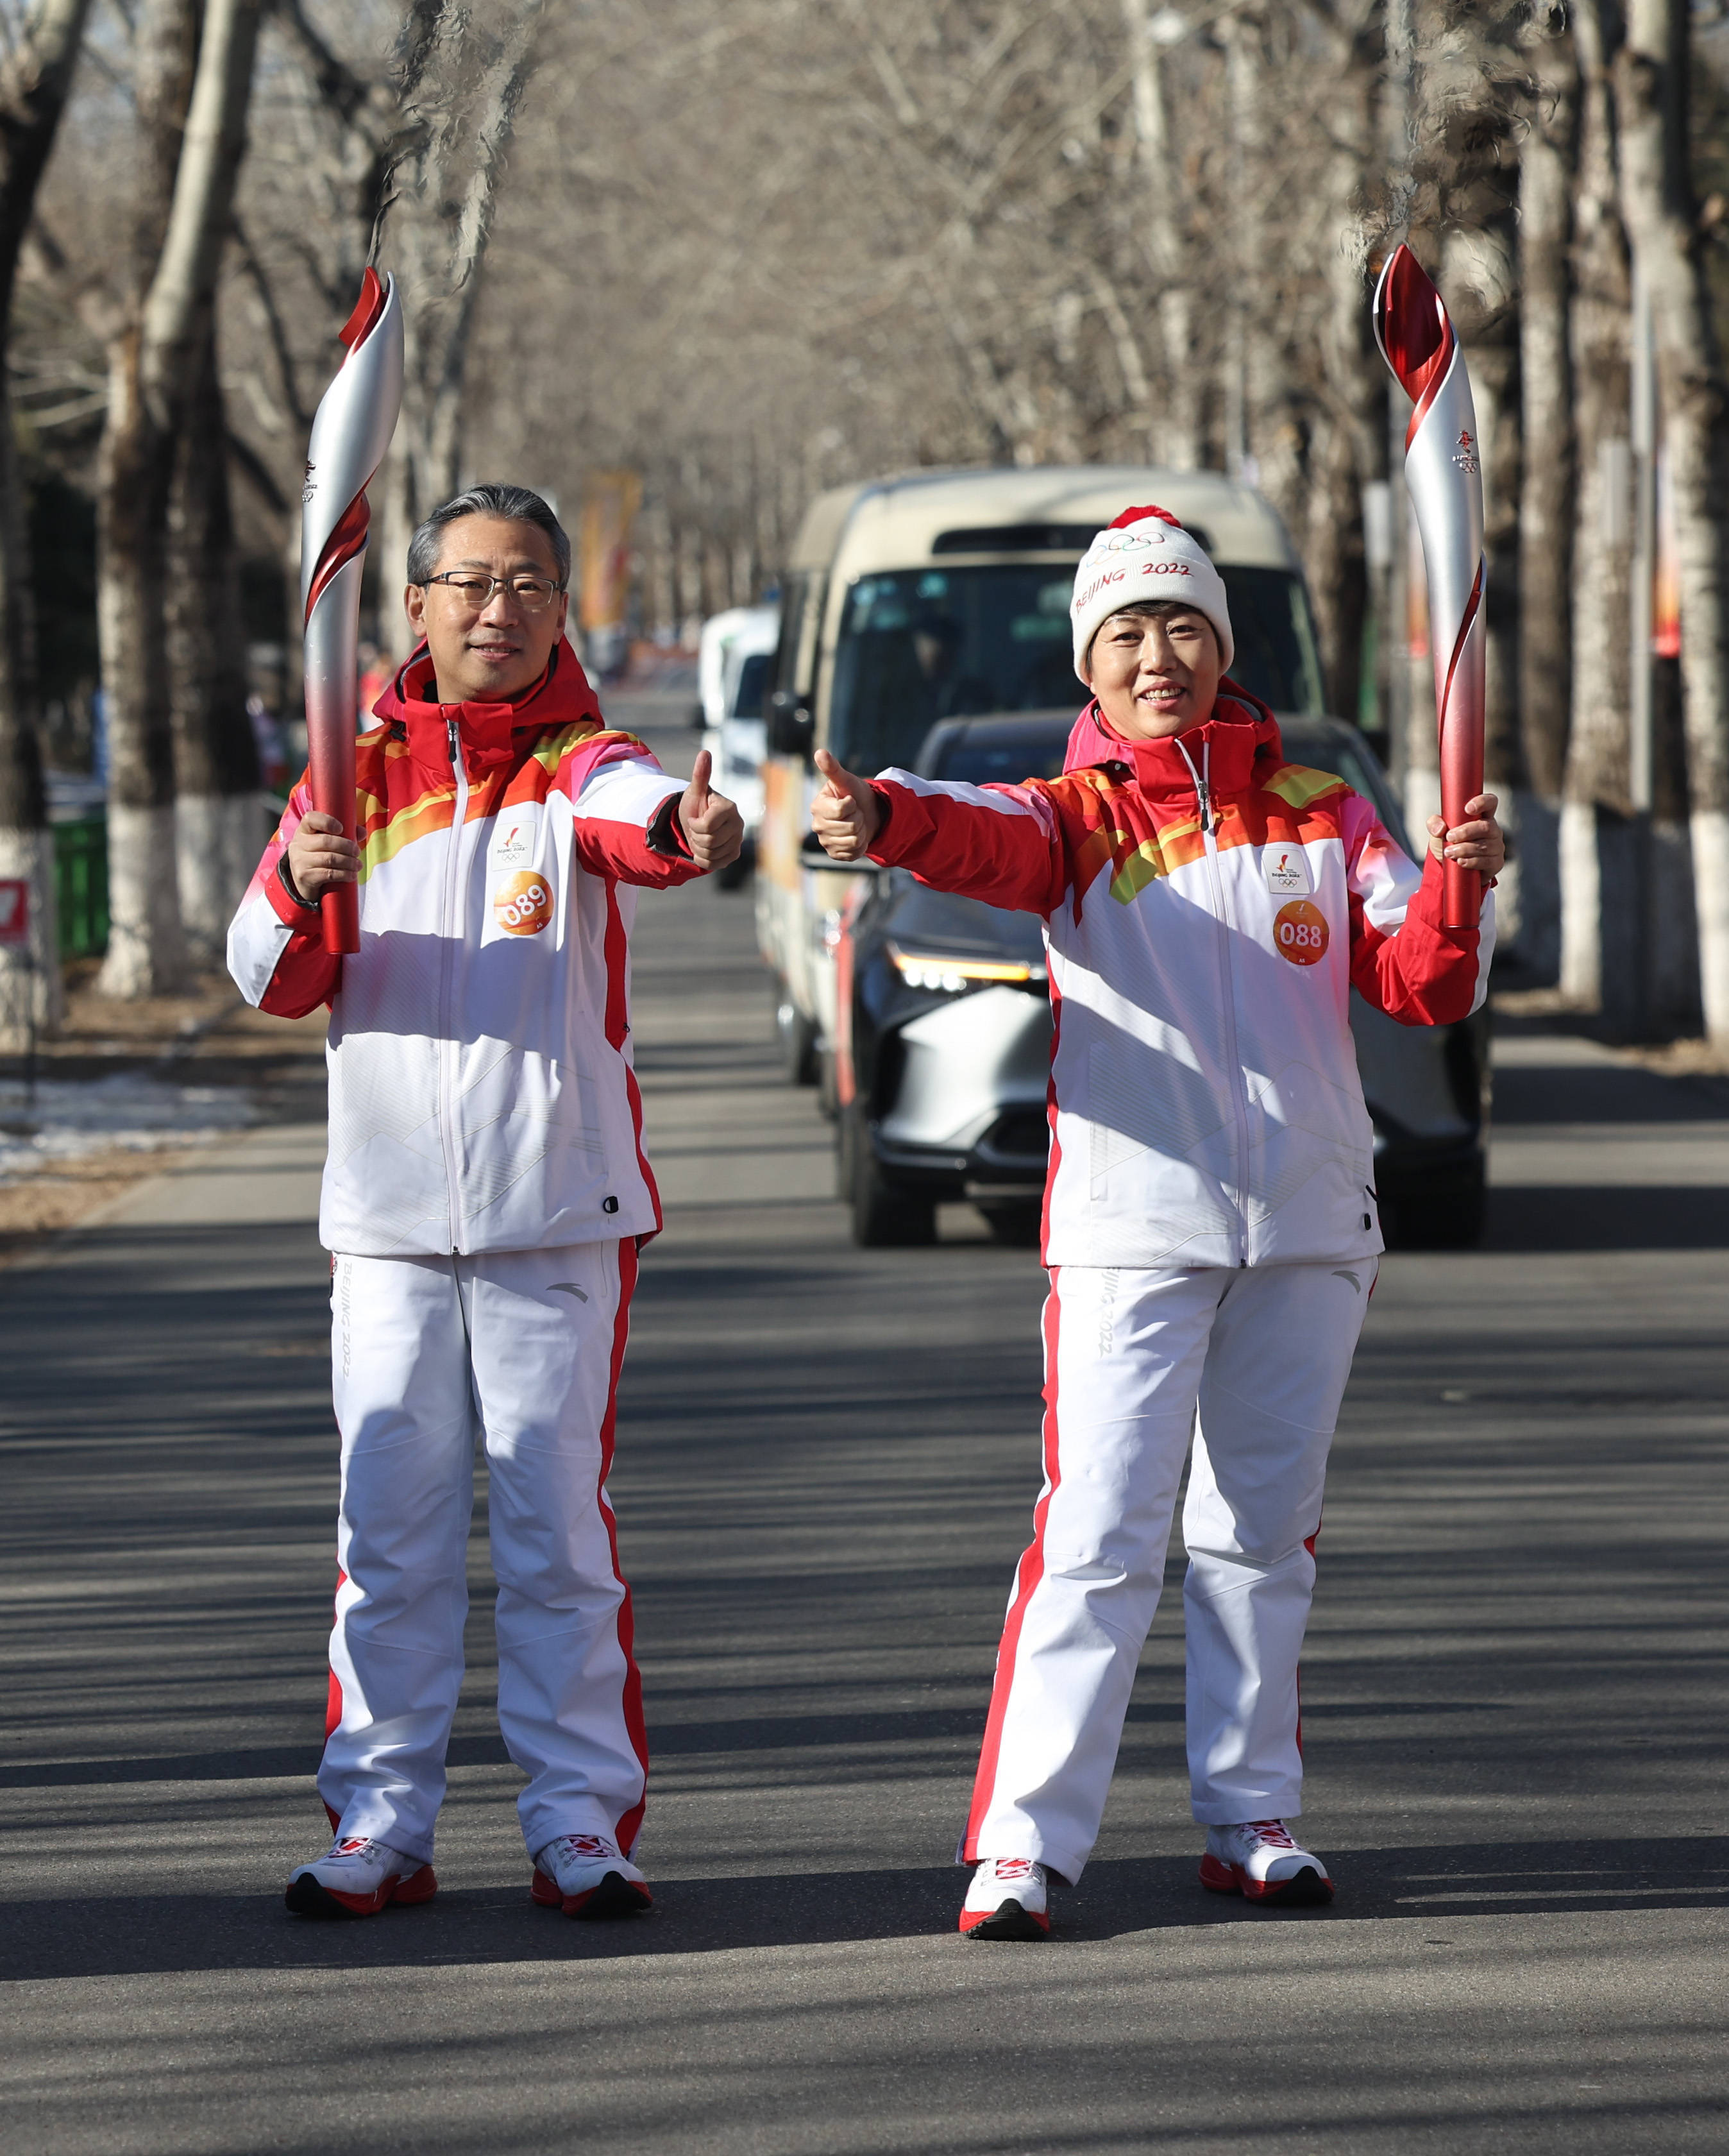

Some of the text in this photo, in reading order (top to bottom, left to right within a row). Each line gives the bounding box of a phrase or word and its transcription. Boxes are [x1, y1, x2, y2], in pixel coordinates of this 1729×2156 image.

[1075, 563, 1195, 615] BEIJING 2022
[503, 885, 546, 926] 089
[1280, 922, 1322, 947] 088
[340, 1262, 353, 1382] BEIJING 2022
[1098, 1311, 1114, 1359] 2022
